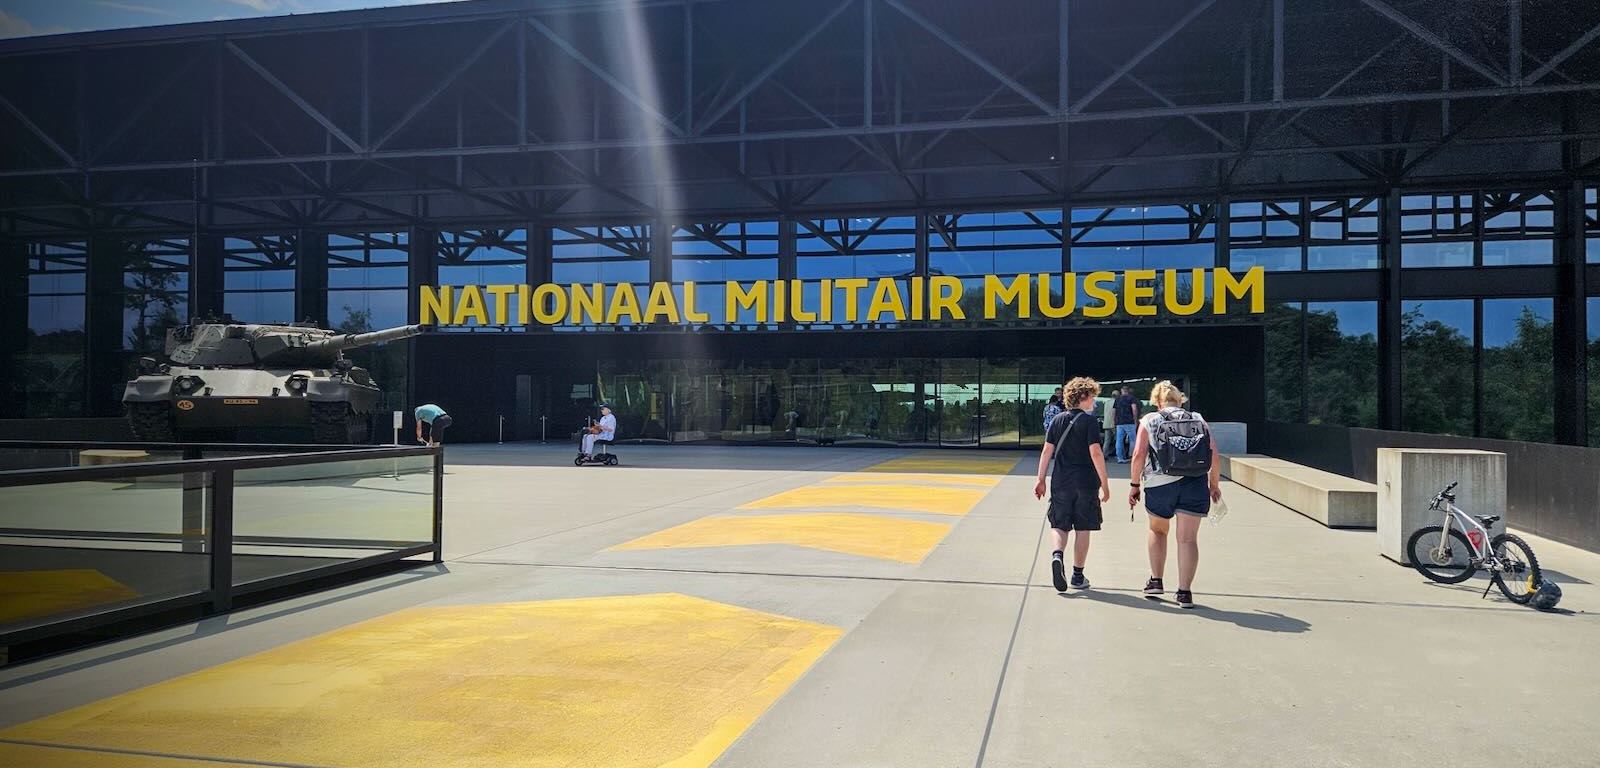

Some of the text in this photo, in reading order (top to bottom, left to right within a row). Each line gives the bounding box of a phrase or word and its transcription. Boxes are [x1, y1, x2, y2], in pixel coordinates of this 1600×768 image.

[420, 266, 1265, 325] NATIONAAL MILITAIR MUSEUM
